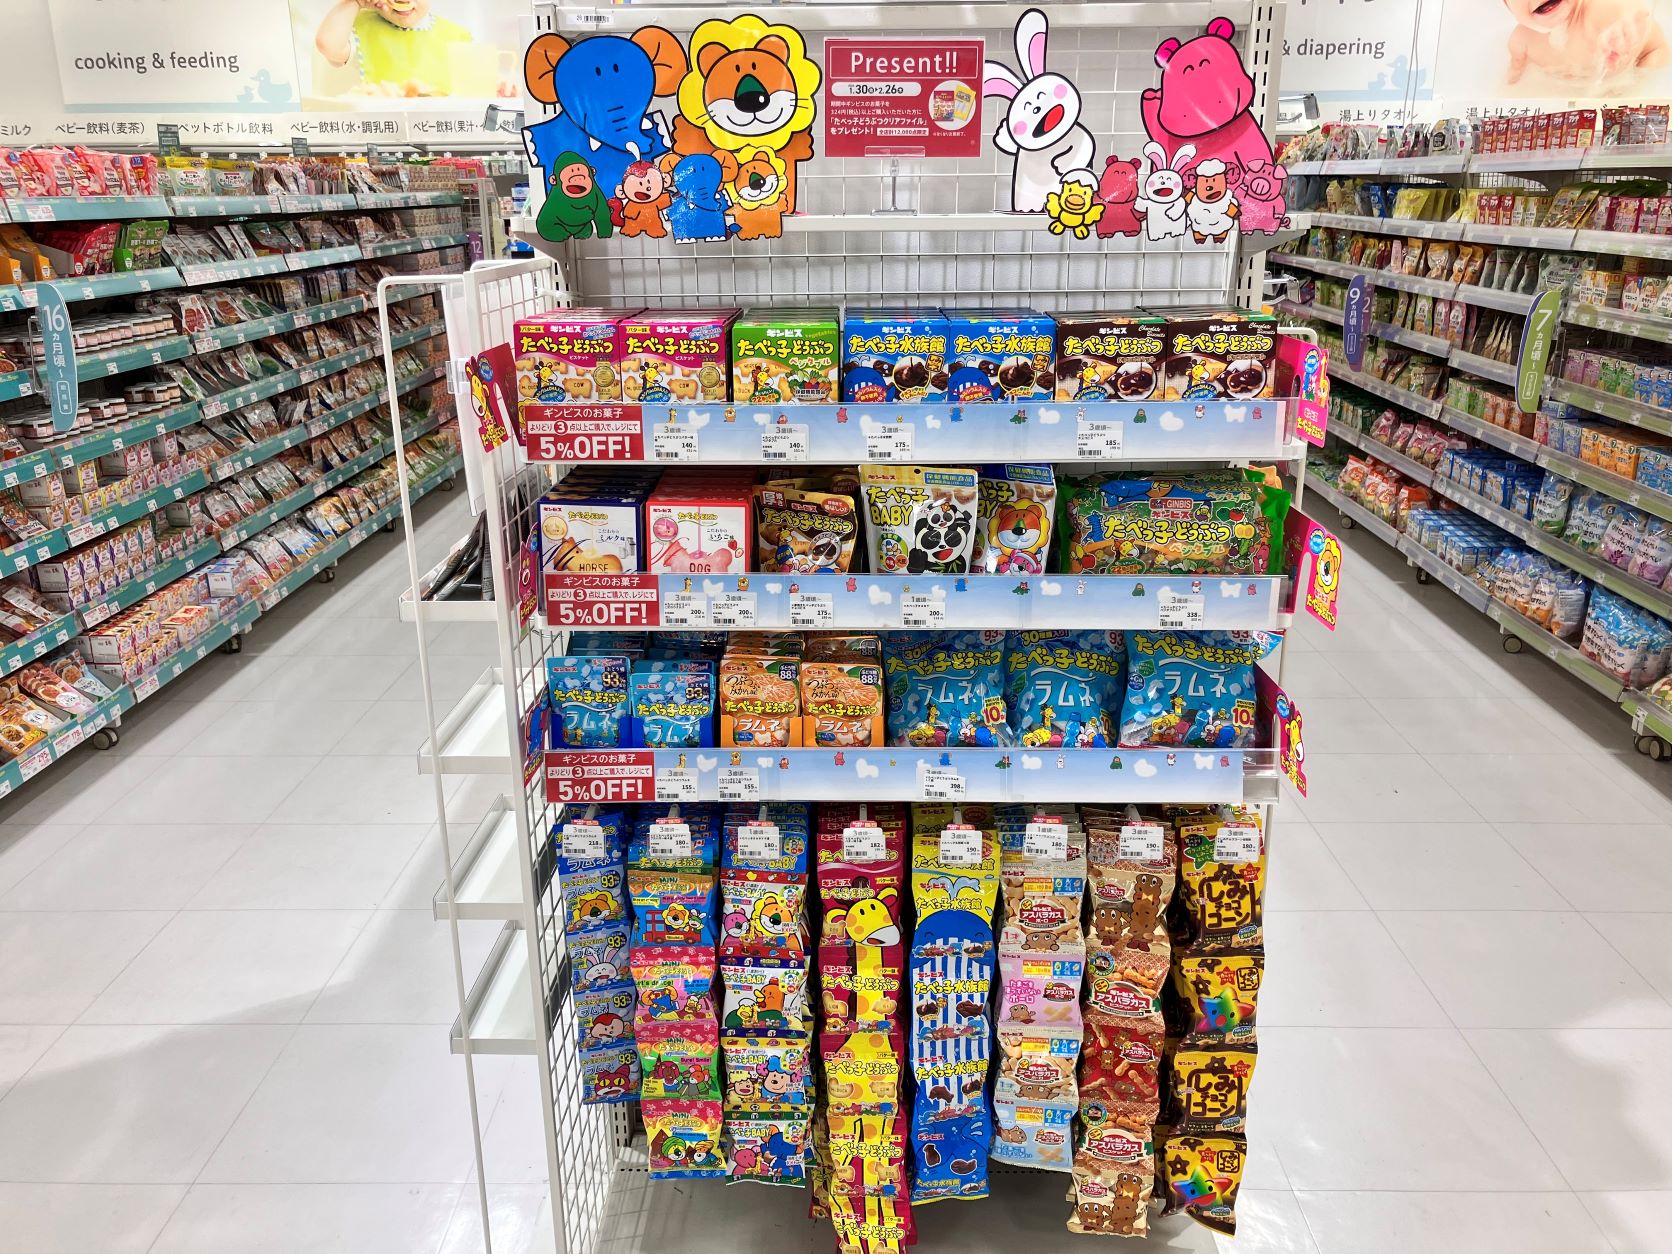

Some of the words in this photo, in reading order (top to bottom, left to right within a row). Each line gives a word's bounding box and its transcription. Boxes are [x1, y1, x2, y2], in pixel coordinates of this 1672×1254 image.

[1296, 38, 1386, 60] diapering
[74, 52, 147, 74] cooking
[152, 52, 165, 69] &
[169, 51, 240, 73] feeding
[851, 51, 957, 73] Present!!
[1340, 108, 1418, 122] 湯上りタオル
[0, 124, 32, 136] ミルク
[55, 122, 146, 135] ベビー飲料(麦茶)
[178, 122, 273, 135] ペットボトル飲料
[471, 241, 482, 254] 12
[766, 328, 803, 338] ギンビス
[520, 336, 614, 354] たべっ子どうぶつ
[626, 336, 720, 354] たべっ子どうぶつ
[736, 338, 834, 358] たべっ子どうぶつ
[848, 335, 946, 354] たべっ子水族館
[954, 335, 1052, 354] たべっ子水族館
[1064, 337, 1162, 356] たべっ子どうぶつ
[1174, 333, 1273, 353] たべっ子どうぶつ
[543, 408, 624, 419] ギンビスのお菓子
[540, 435, 631, 459] 5%OFF!
[866, 485, 930, 506] たべっ子
[1166, 499, 1192, 508] GINBIS
[762, 508, 854, 533] たべっ子どうぶつ
[870, 505, 914, 526] BABY
[1104, 519, 1231, 544] たべっ子どうぶつ
[1168, 543, 1227, 557] ベジタブル
[688, 562, 712, 573] DOG
[563, 576, 640, 588] ギンビスのお菓子
[560, 603, 647, 624] 5%OFF!
[1134, 633, 1254, 666] たべっ子どうぶつ
[886, 650, 1002, 676] たべっ子どうぶつ
[1008, 647, 1120, 676] たべっ子どうぶつ
[1164, 670, 1227, 698] ラムネ
[554, 688, 626, 704] たべっ子どうぶつ
[918, 680, 977, 706] ラムネ
[1036, 684, 1090, 708] ラムネ
[637, 703, 710, 718] たべっ子どうぶつ
[724, 700, 797, 714] たべっ子どうぶつ
[806, 702, 879, 716] たべっ子どうぶつ
[566, 711, 611, 730] ラムネ
[738, 719, 782, 732] ラムネ
[820, 722, 864, 734] ラムネ
[562, 754, 637, 764] ギンビスのお菓子
[558, 780, 643, 800] 5%OFF!
[820, 886, 876, 900] たべっ子どうぶつ
[1206, 880, 1250, 902] しみ
[916, 896, 983, 911] たべっ子水族館
[1214, 900, 1242, 912] チョコ
[1022, 911, 1062, 919] アスパラガス
[1208, 911, 1250, 928] コーン
[821, 974, 900, 992] たべっ子どうぶつ
[914, 980, 988, 994] たべっ子水族館
[1010, 995, 1034, 1003] ボーロ
[1096, 992, 1148, 1008] アスパラガス
[726, 1054, 768, 1064] たべっ子BABY
[825, 1060, 900, 1077] たべっ子どうぶつ
[916, 1060, 989, 1080] たべっ子水族館
[1194, 1074, 1238, 1094] しみ
[1200, 1092, 1228, 1103] チョコ
[1192, 1102, 1236, 1117] コーン
[829, 1140, 902, 1158] たべっ子どうぶつ
[1090, 1140, 1140, 1152] アスパラガス
[833, 1221, 906, 1240] たべっ子どうぶつ
